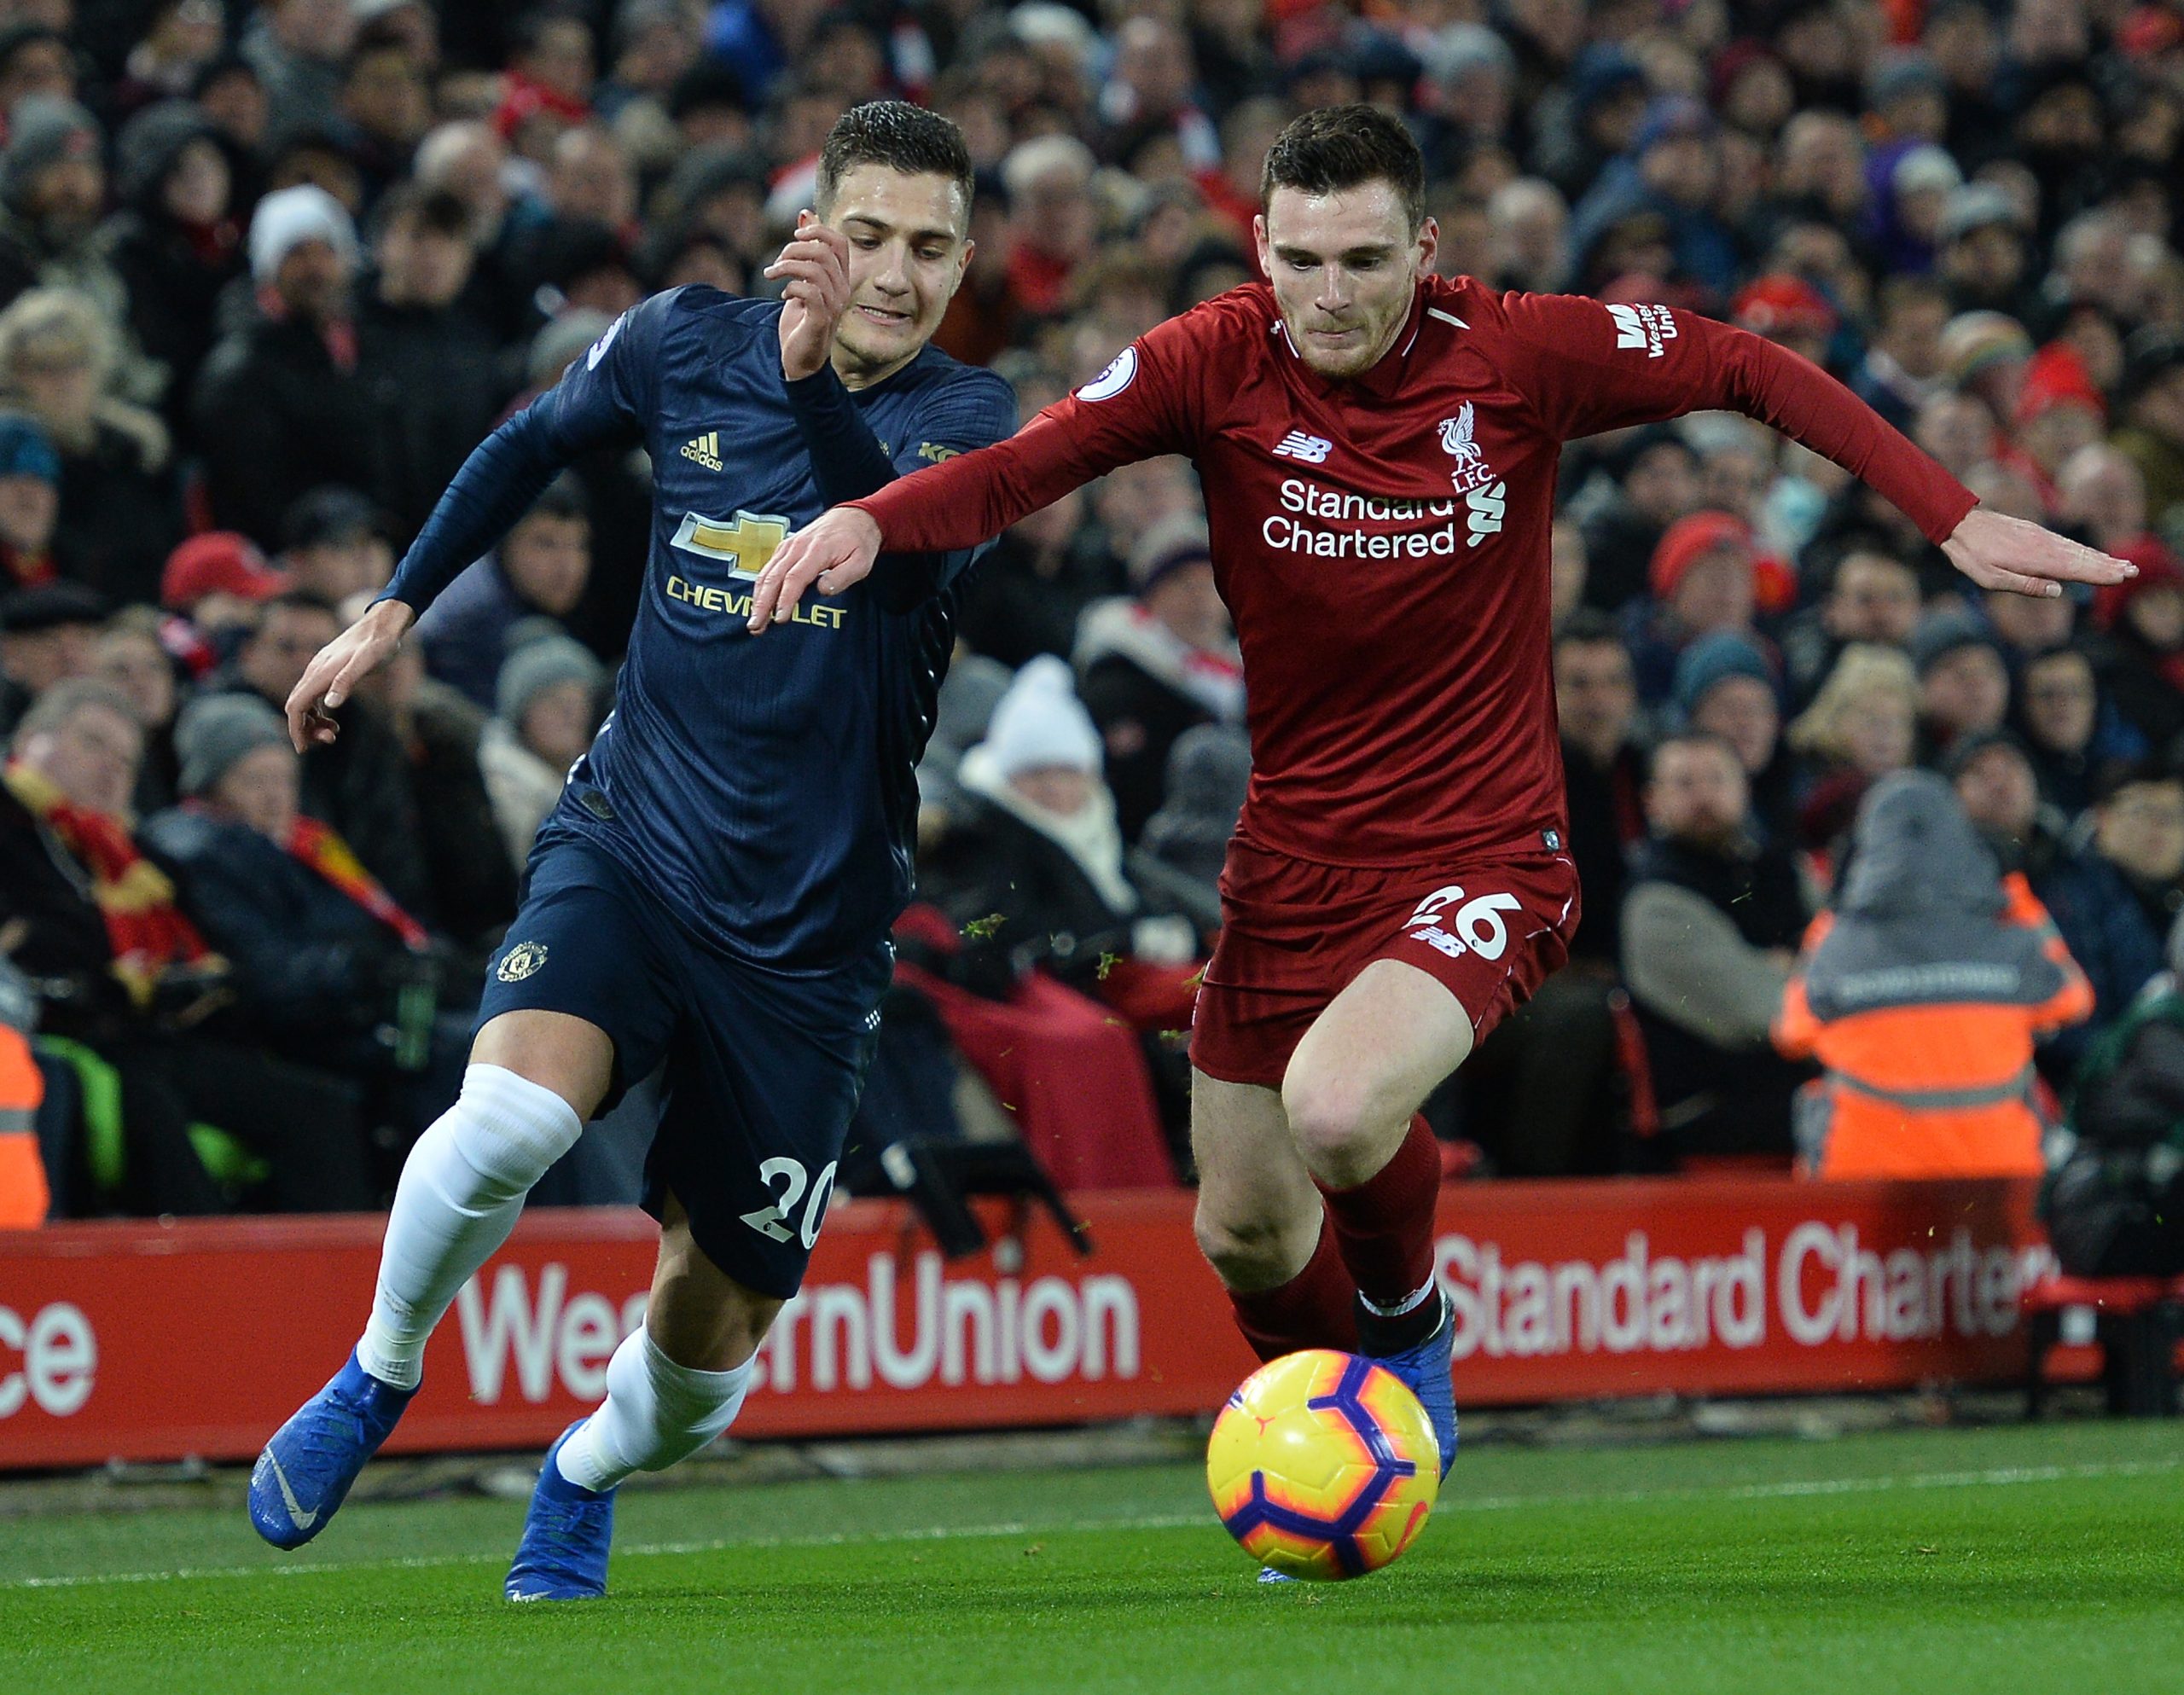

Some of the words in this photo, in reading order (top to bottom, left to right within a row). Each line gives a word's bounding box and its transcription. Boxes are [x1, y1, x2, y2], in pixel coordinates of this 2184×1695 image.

[680, 445, 723, 472] adidas
[1263, 515, 1455, 559] Chartered
[1400, 885, 1523, 961] 26
[739, 1156, 838, 1250] 20
[1434, 1225, 1767, 1361] Standard
